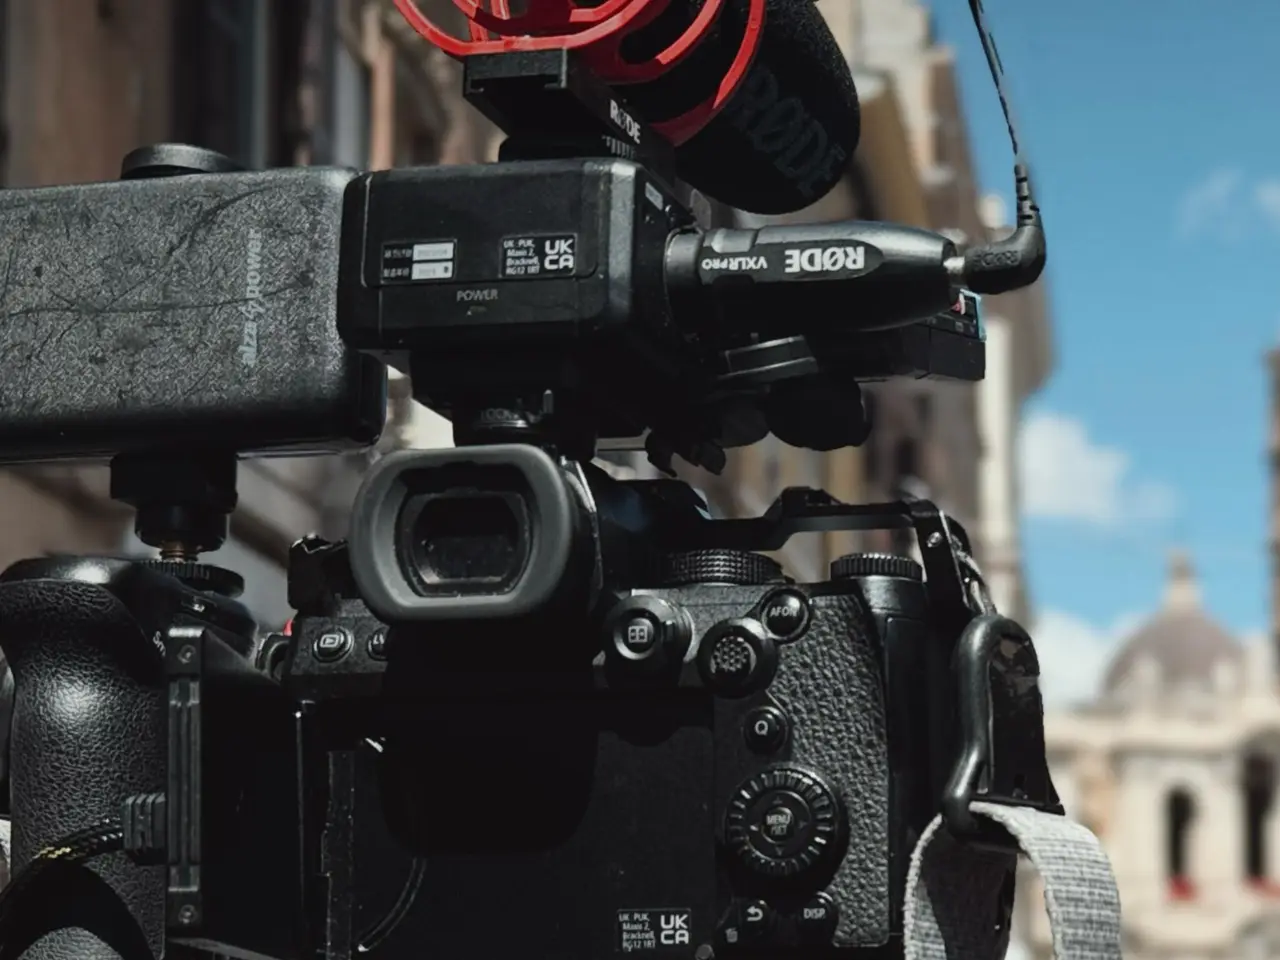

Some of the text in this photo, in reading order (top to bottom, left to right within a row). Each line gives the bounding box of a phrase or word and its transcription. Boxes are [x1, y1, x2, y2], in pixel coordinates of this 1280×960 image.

[544, 239, 573, 254] UK
[544, 254, 574, 270] CA
[784, 246, 865, 273] RØDE
[456, 288, 498, 302] POWER
[755, 720, 769, 736] Q
[660, 914, 688, 929] UK
[660, 929, 690, 945] CA
